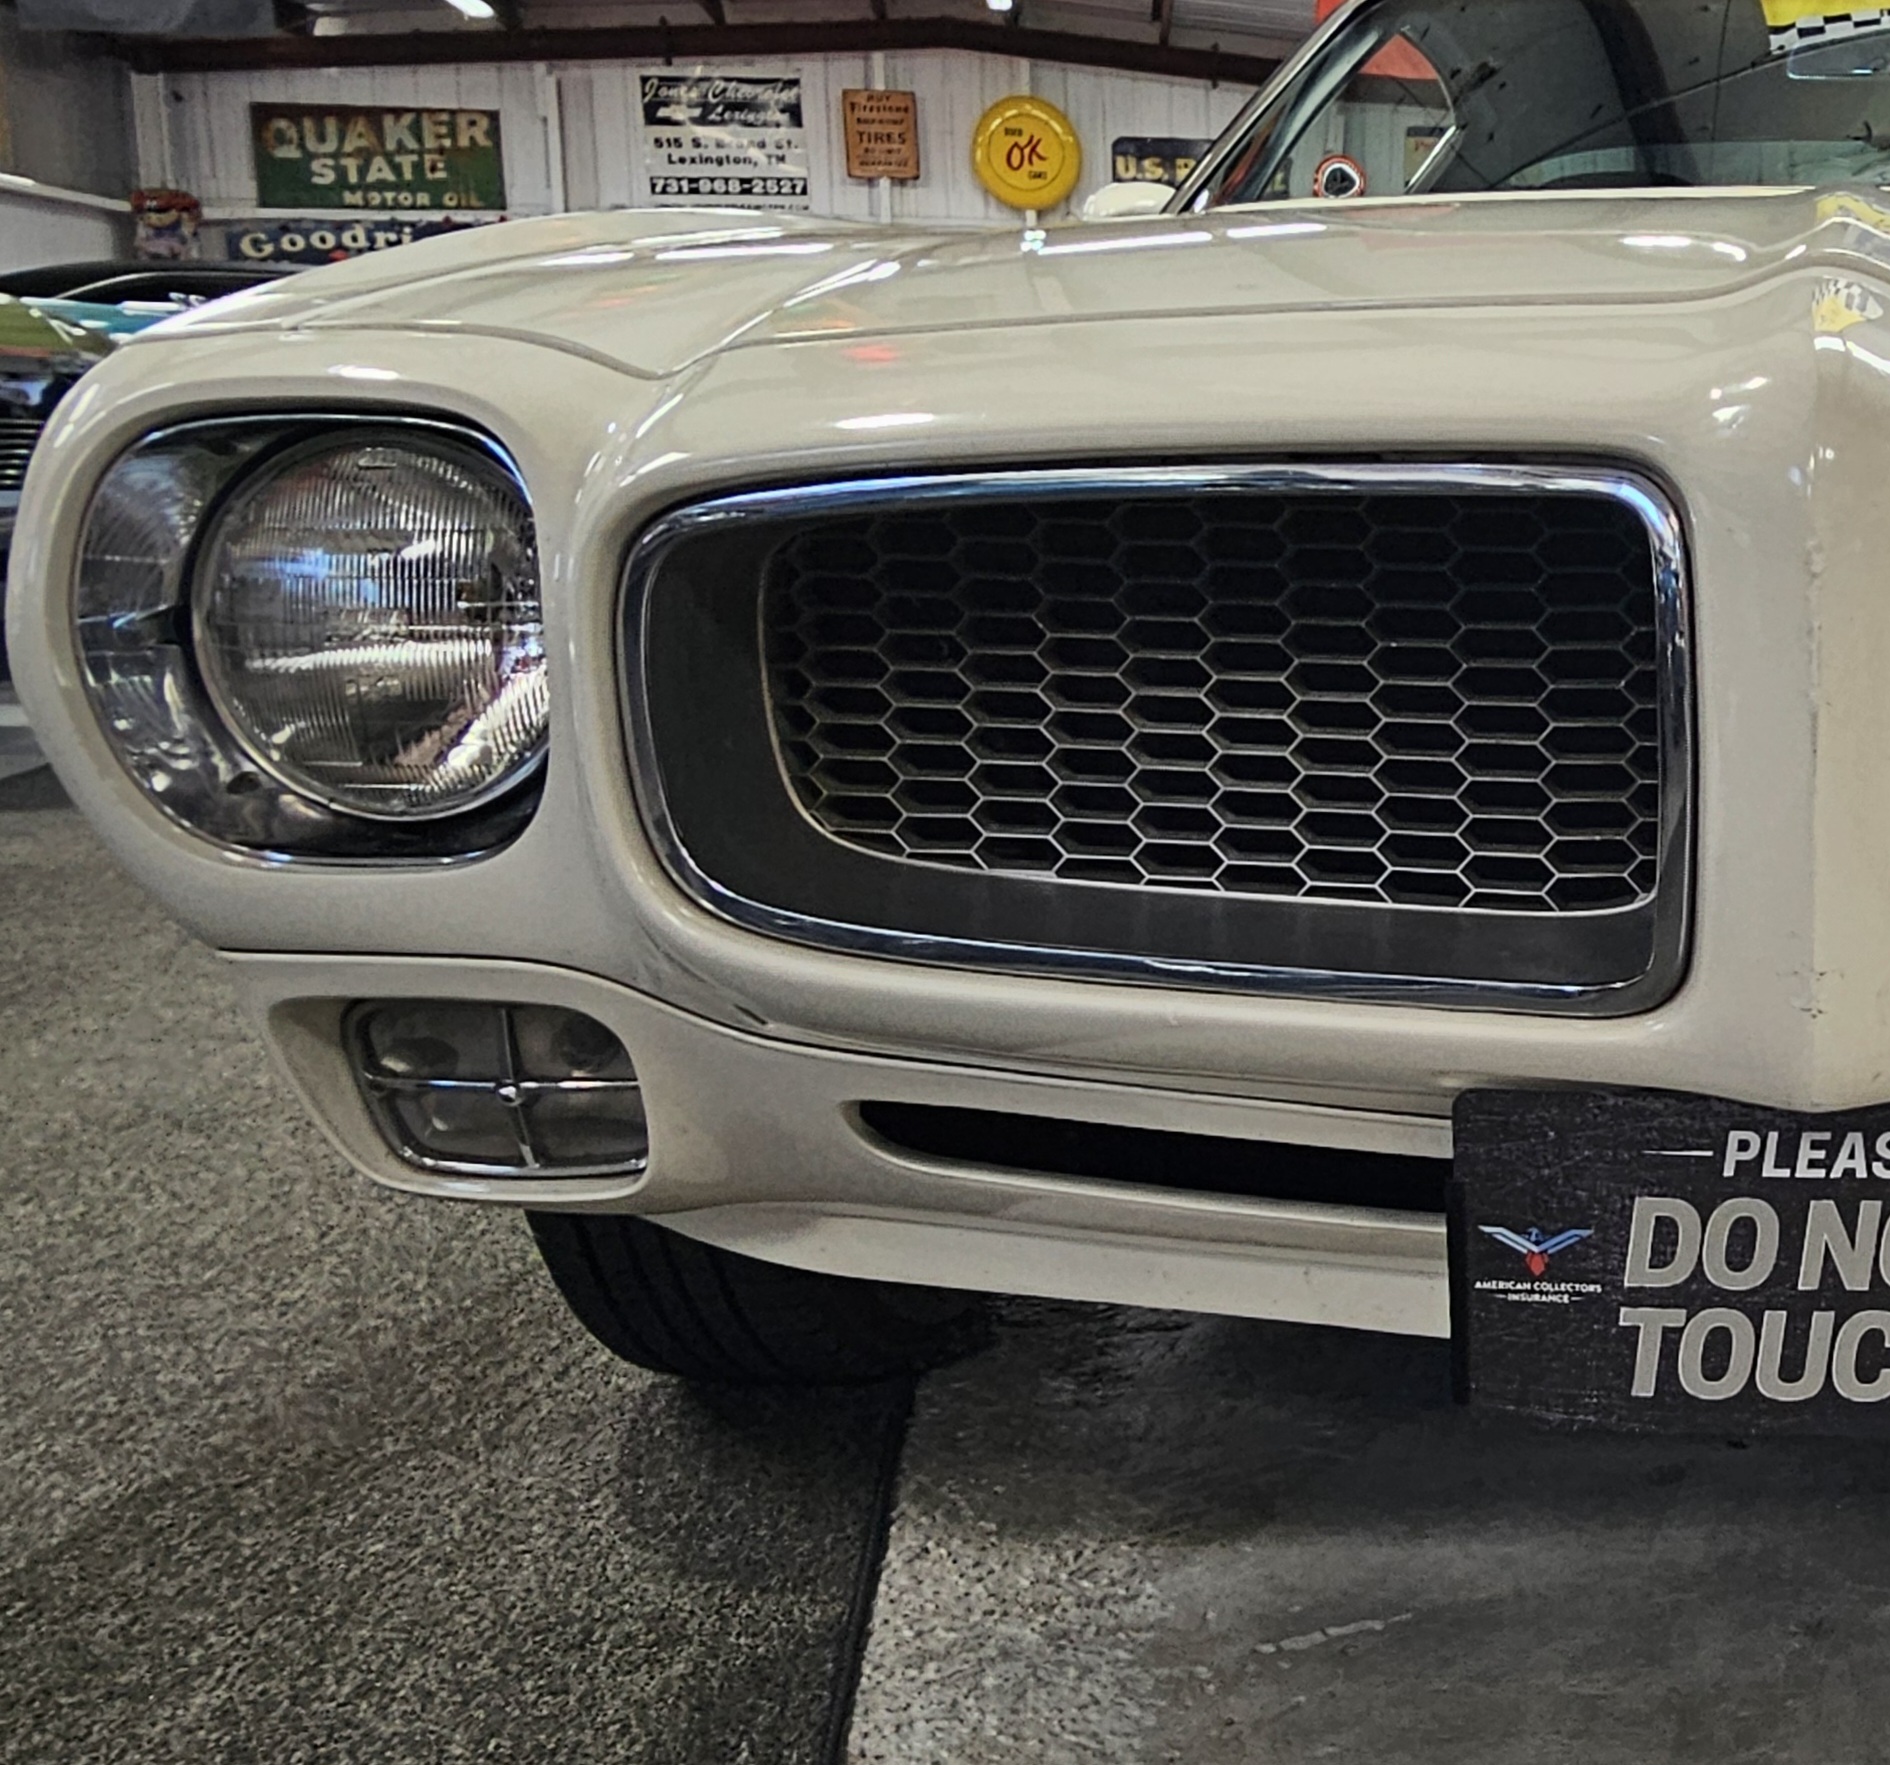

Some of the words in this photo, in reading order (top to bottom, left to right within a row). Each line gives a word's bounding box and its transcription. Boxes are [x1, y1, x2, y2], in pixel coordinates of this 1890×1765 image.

[262, 111, 493, 158] QUAKER
[654, 137, 683, 149] 515
[857, 131, 906, 144] TIRES
[667, 153, 758, 167] Lexington,
[1006, 134, 1048, 171] OK
[311, 154, 447, 185] STATE
[343, 190, 430, 207] MOTOR
[443, 191, 485, 207] OIL
[241, 224, 413, 259] Goodri
[1624, 1196, 1780, 1291] DO
[1474, 1280, 1531, 1290] AMERICAN
[1533, 1281, 1602, 1293] COLLECTORS
[1507, 1293, 1570, 1304] INSURANCE
